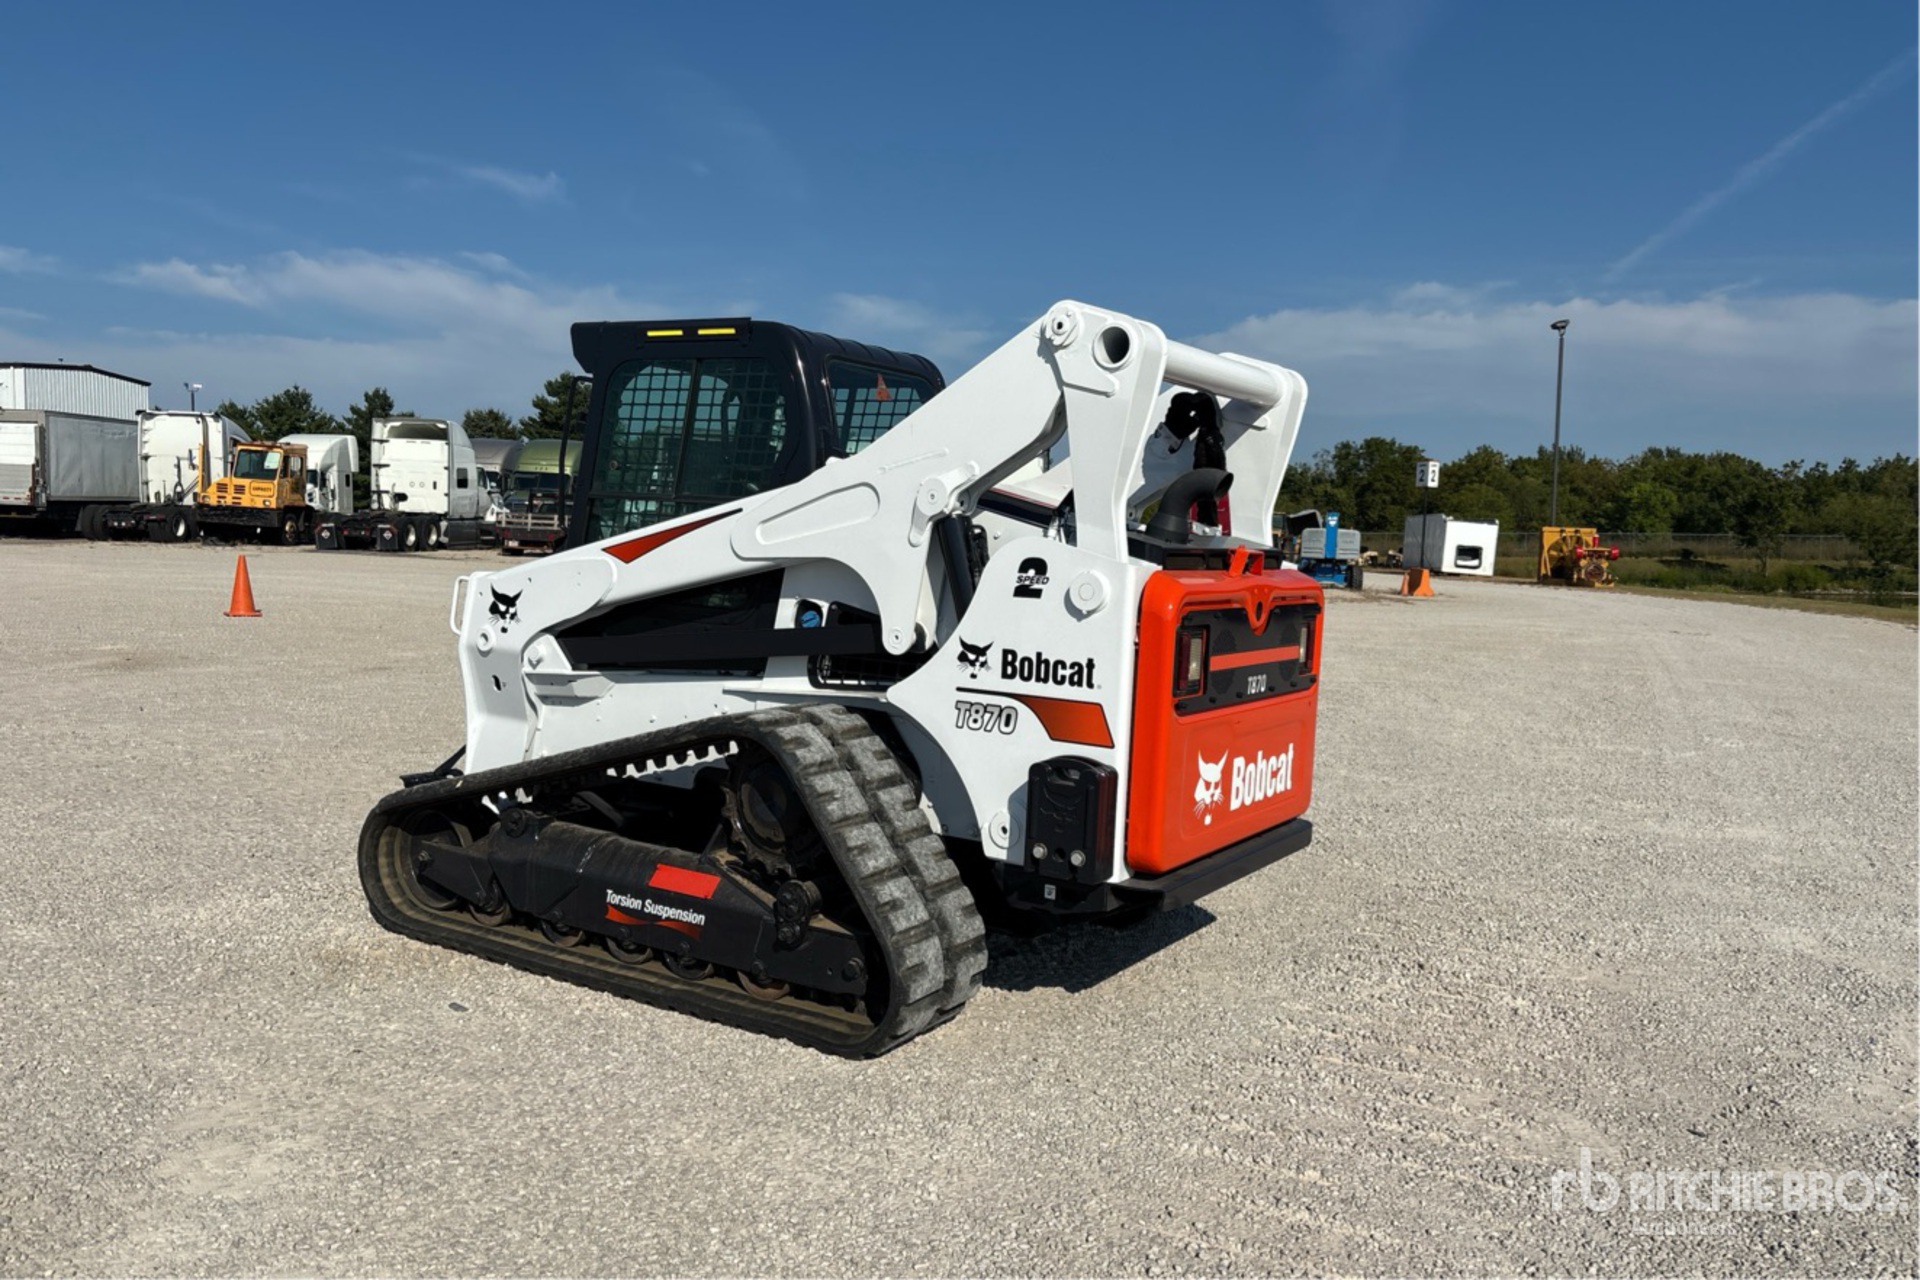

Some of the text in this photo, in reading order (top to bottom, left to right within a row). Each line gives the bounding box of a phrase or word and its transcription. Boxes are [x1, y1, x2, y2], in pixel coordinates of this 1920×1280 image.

[1419, 469, 1425, 482] 2
[1430, 469, 1436, 482] 2
[1013, 557, 1048, 599] 2
[1016, 575, 1049, 585] SPEED
[1001, 648, 1096, 689] Bobcat
[1247, 674, 1267, 694] T870
[955, 700, 1018, 735] T870
[1230, 743, 1294, 811] Bobcat
[606, 889, 705, 926] Torsion Suspension
